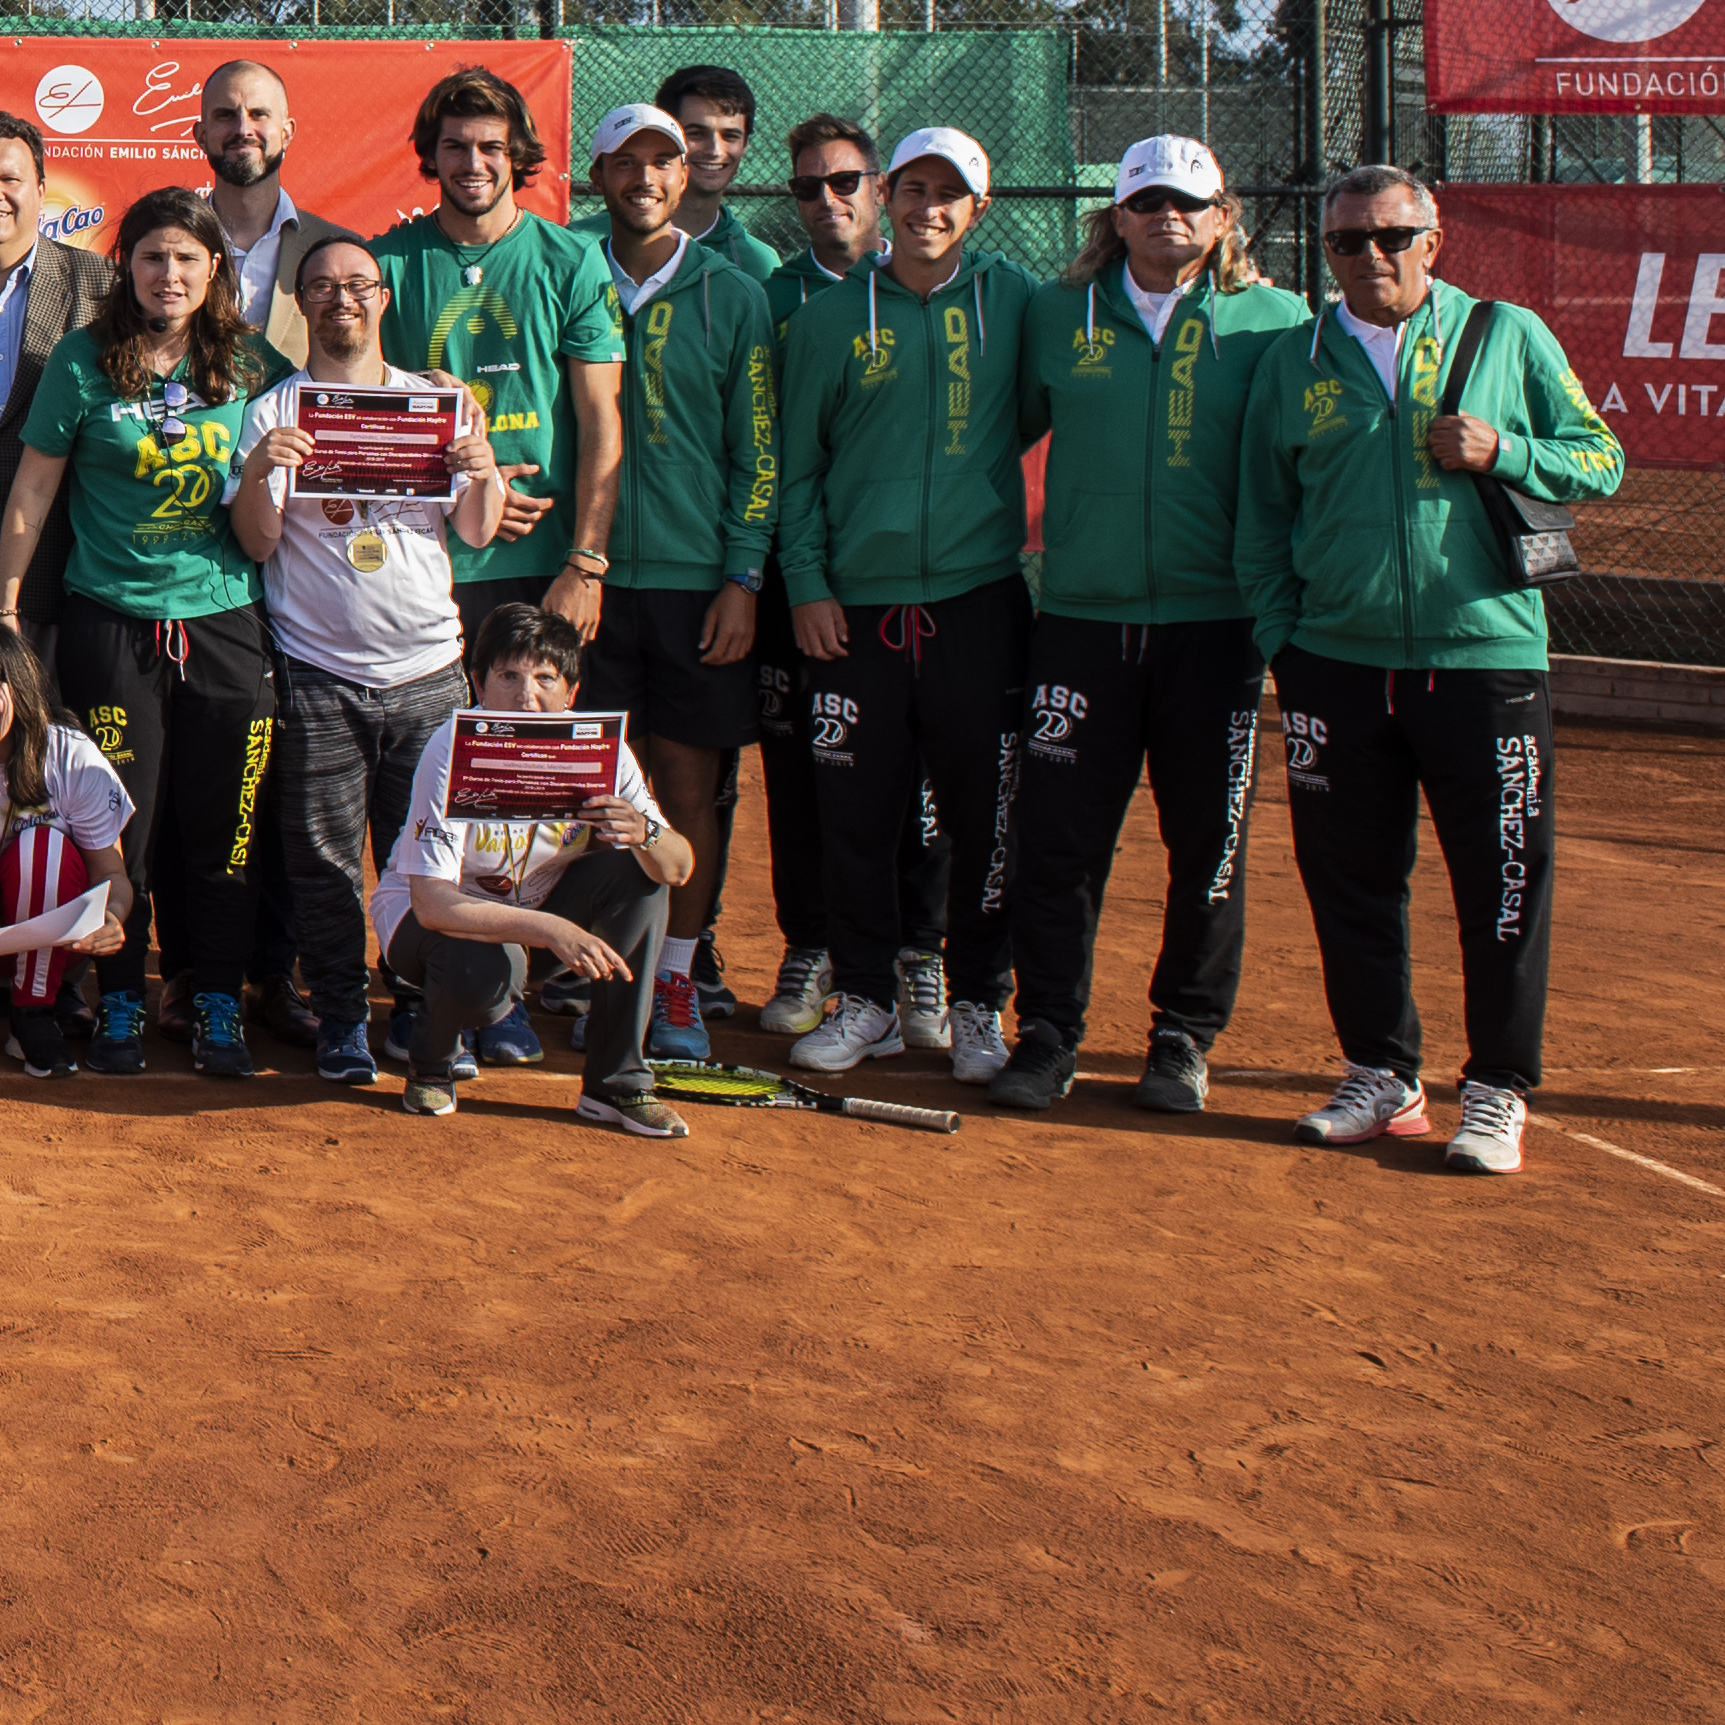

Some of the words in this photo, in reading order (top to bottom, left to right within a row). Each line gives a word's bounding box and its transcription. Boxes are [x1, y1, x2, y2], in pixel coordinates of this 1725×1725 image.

[1555, 65, 1725, 96] FUNDACIÓ
[43, 144, 103, 159] NDACIÓN
[110, 147, 157, 160] EMILIO
[477, 363, 522, 374] HEAD
[944, 307, 971, 456] HEAD
[1166, 317, 1204, 468] HEAD
[1303, 379, 1344, 411] ASC
[134, 421, 231, 478] ASC
[89, 705, 128, 728] ASC
[811, 692, 860, 725] ASC
[1031, 683, 1090, 720] ASC
[1281, 711, 1329, 745] ASC
[1523, 734, 1540, 818] academia
